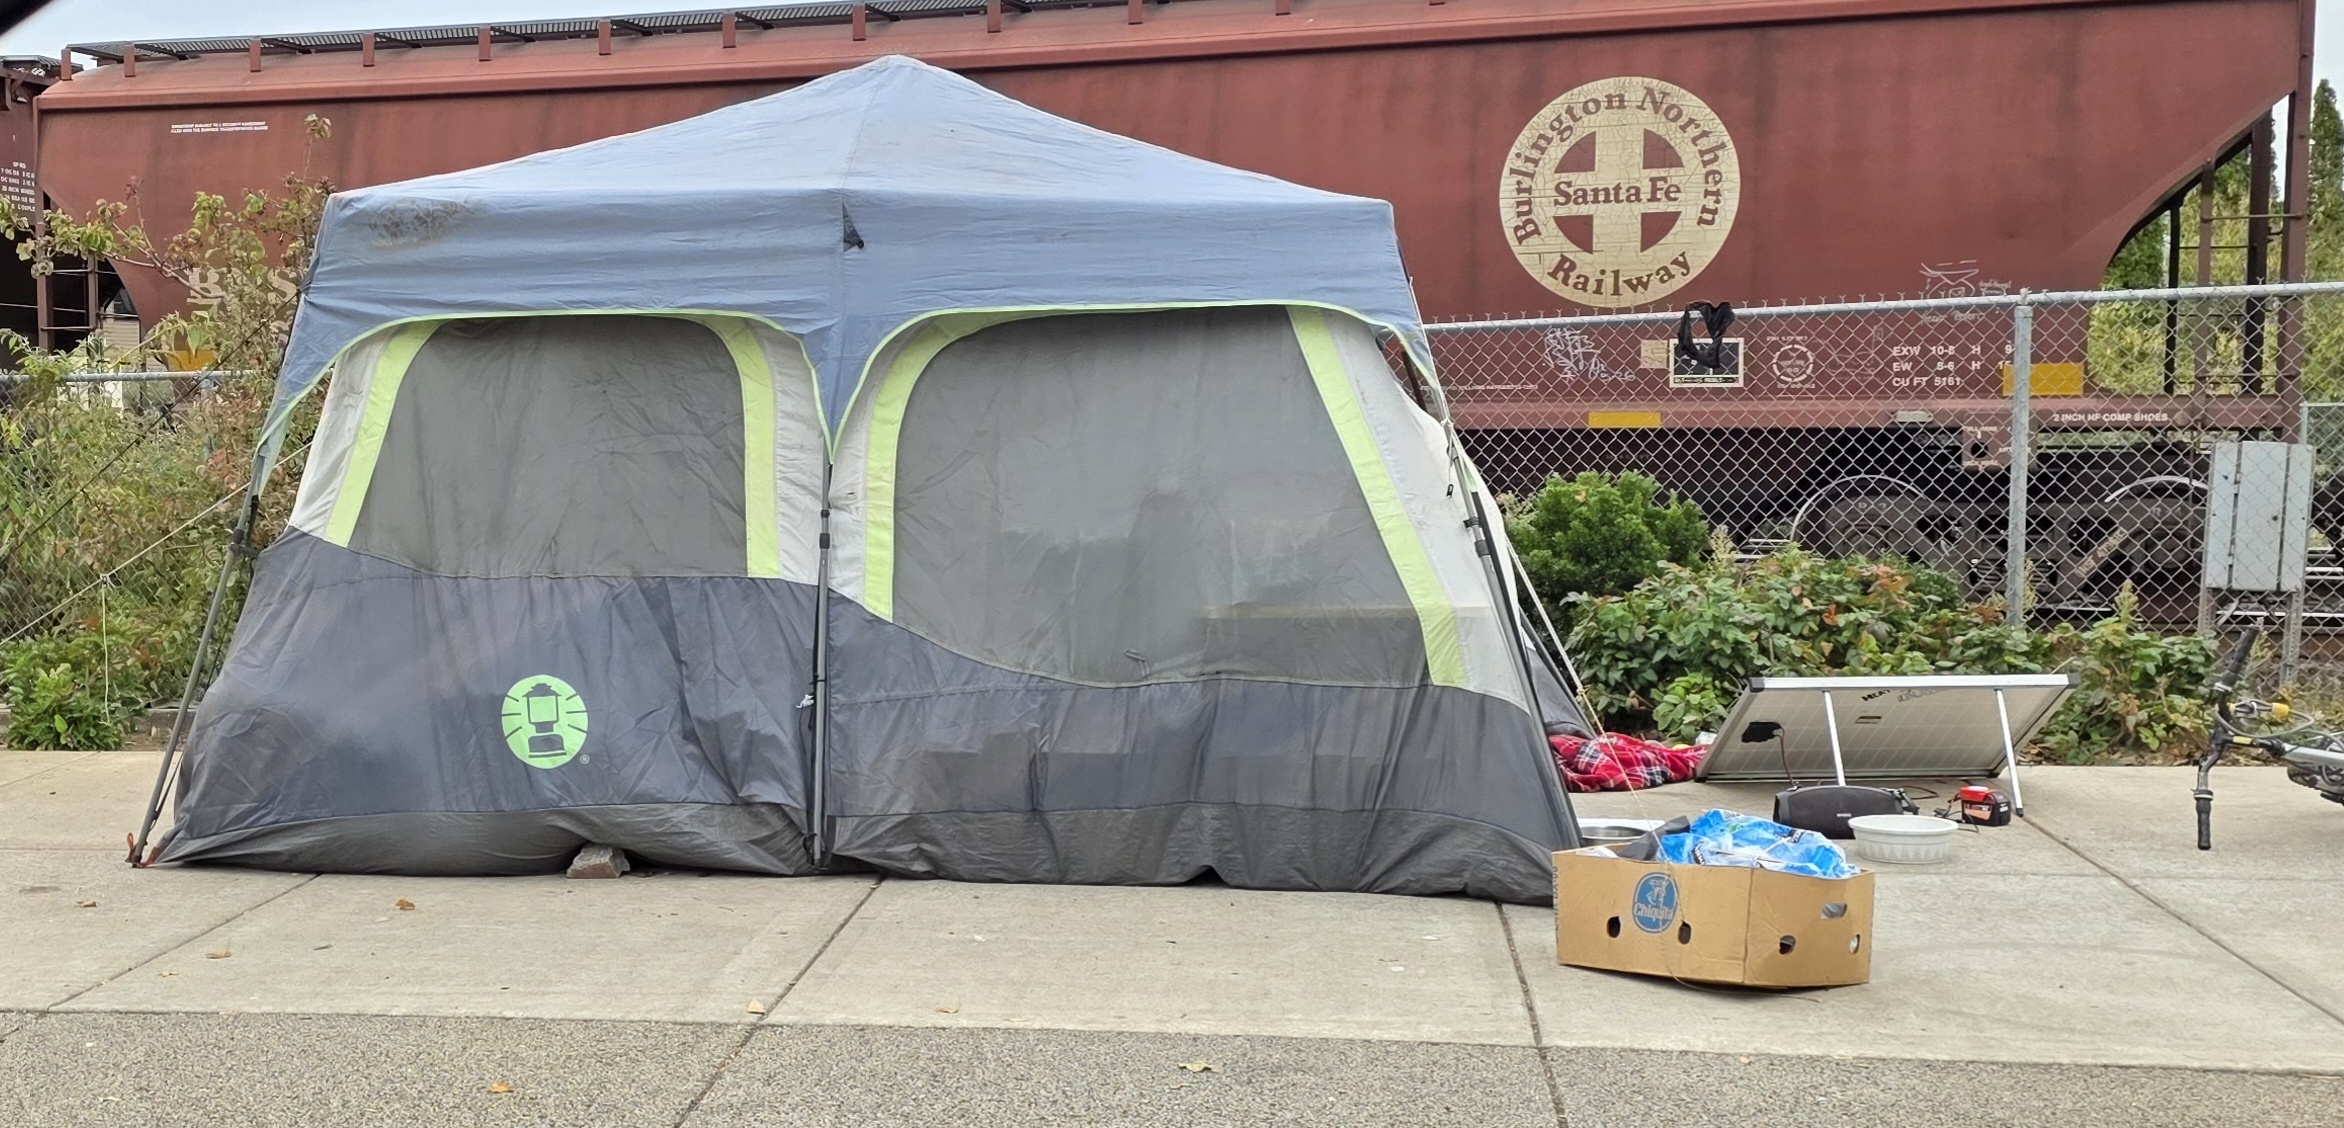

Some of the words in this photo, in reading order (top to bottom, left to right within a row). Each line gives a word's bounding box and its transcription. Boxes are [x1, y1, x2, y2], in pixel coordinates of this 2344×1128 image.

[1509, 91, 1629, 245] Burlington
[1636, 86, 1730, 227] Northern
[1553, 181, 1643, 207] Santa
[1647, 176, 1682, 203] Fe
[1547, 251, 1692, 297] Railway
[1893, 346, 1921, 356] EXW
[1971, 344, 1981, 355] H
[1892, 362, 1912, 372] EW
[1971, 361, 1981, 371] H
[1892, 377, 1910, 387] CU
[1913, 377, 1928, 386] FT
[2053, 413, 2060, 422] 2
[2061, 413, 2086, 422] INCH
[2102, 413, 2132, 422] COMP
[2133, 413, 2169, 422] SHOES
[1633, 901, 1676, 922] Chiquita
